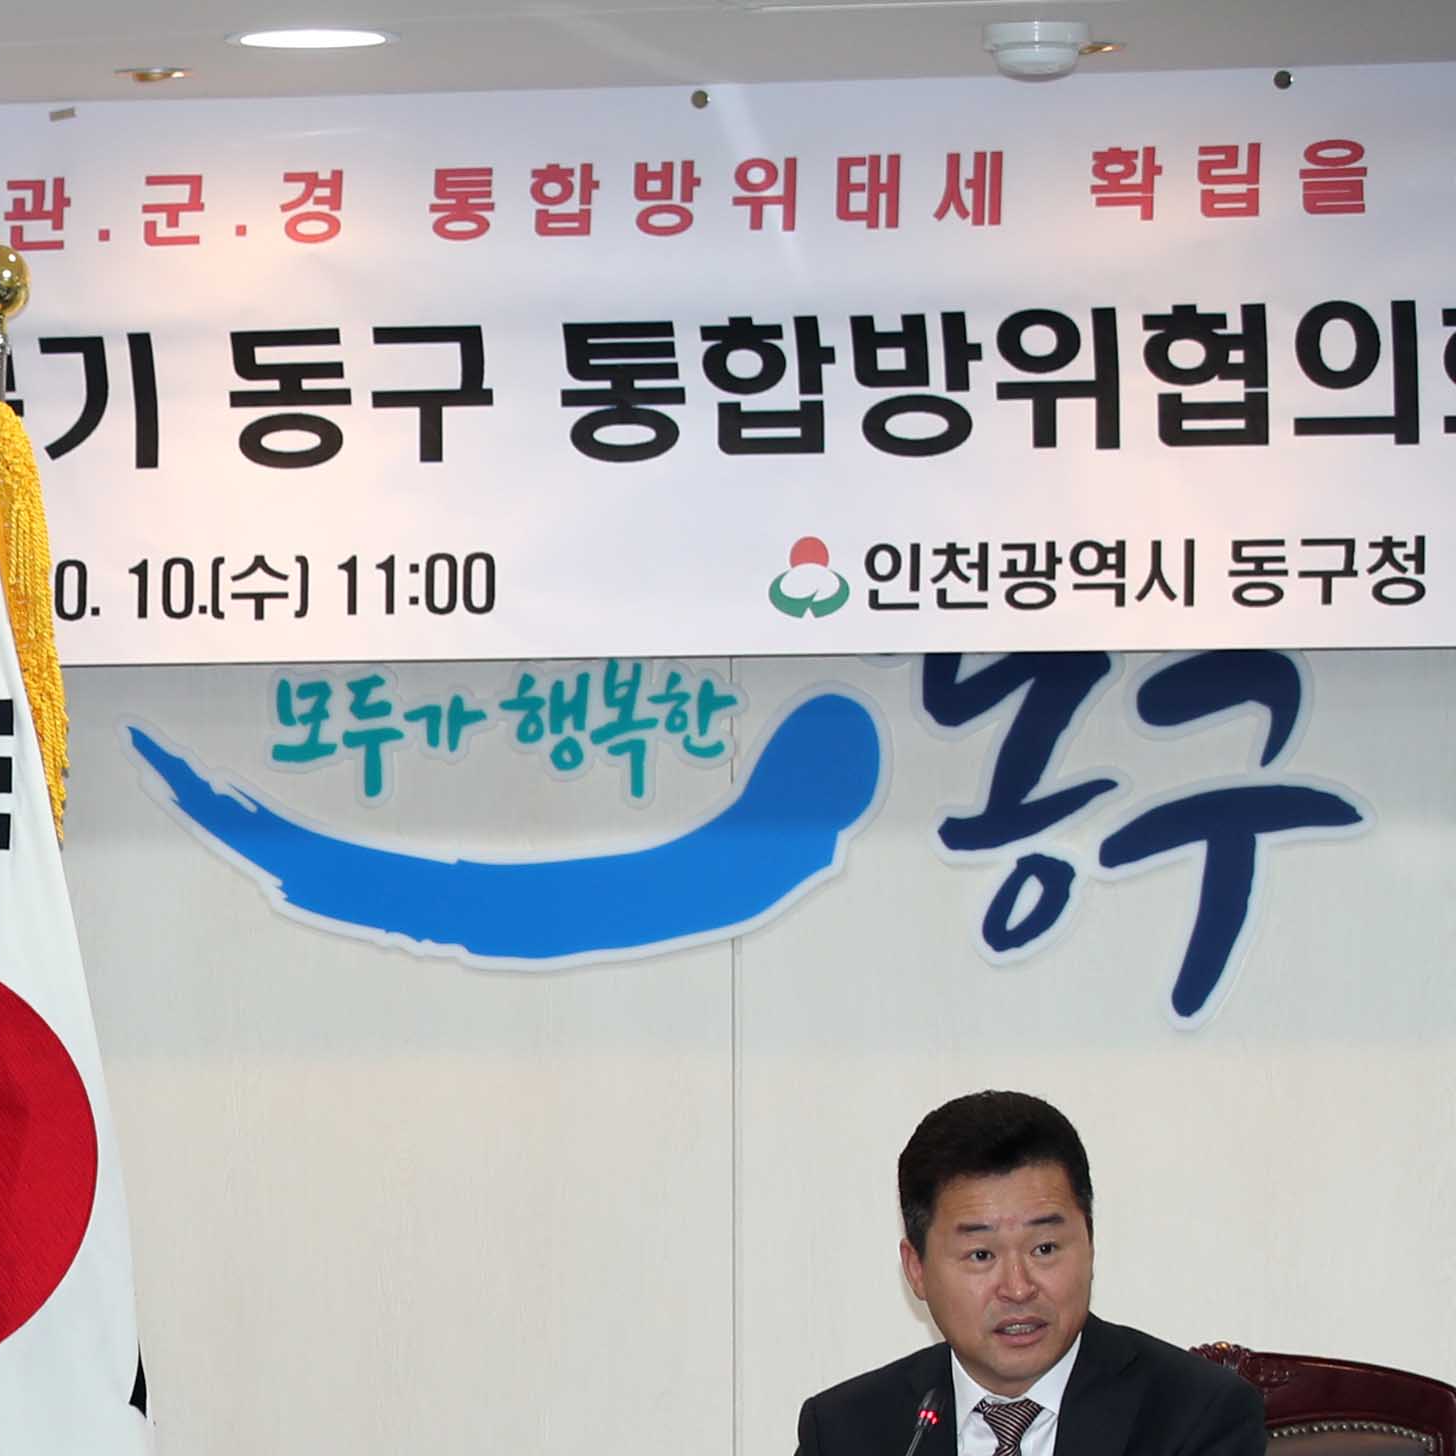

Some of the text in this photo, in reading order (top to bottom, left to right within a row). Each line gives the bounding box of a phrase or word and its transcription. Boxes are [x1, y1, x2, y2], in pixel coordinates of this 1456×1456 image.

[430, 151, 1005, 241] 통합방위태세
[1090, 139, 1368, 222] 확립을
[228, 324, 495, 470] 동구
[559, 299, 1456, 464] 통합방위협의
[337, 551, 497, 617] 11:00
[863, 534, 1427, 612] 인천광역시 동구청
[271, 651, 1365, 1020] 모두가 행복한 동구
